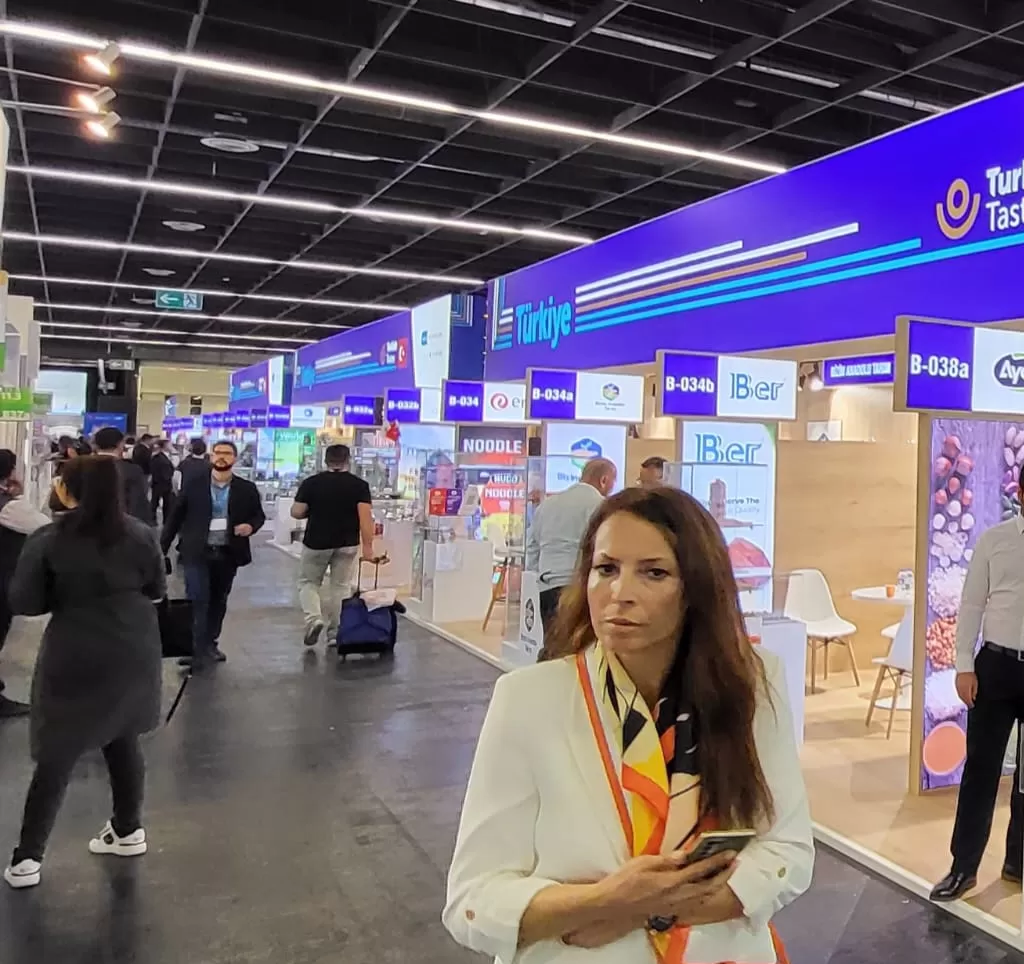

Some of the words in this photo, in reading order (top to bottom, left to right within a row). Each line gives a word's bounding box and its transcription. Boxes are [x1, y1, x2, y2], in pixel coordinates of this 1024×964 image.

[515, 295, 572, 349] Türkiye
[909, 353, 970, 380] B-038a
[665, 375, 716, 393] B-034b
[448, 395, 480, 407] B-034
[532, 387, 575, 403] B-034a
[462, 438, 524, 454] NOODLE
